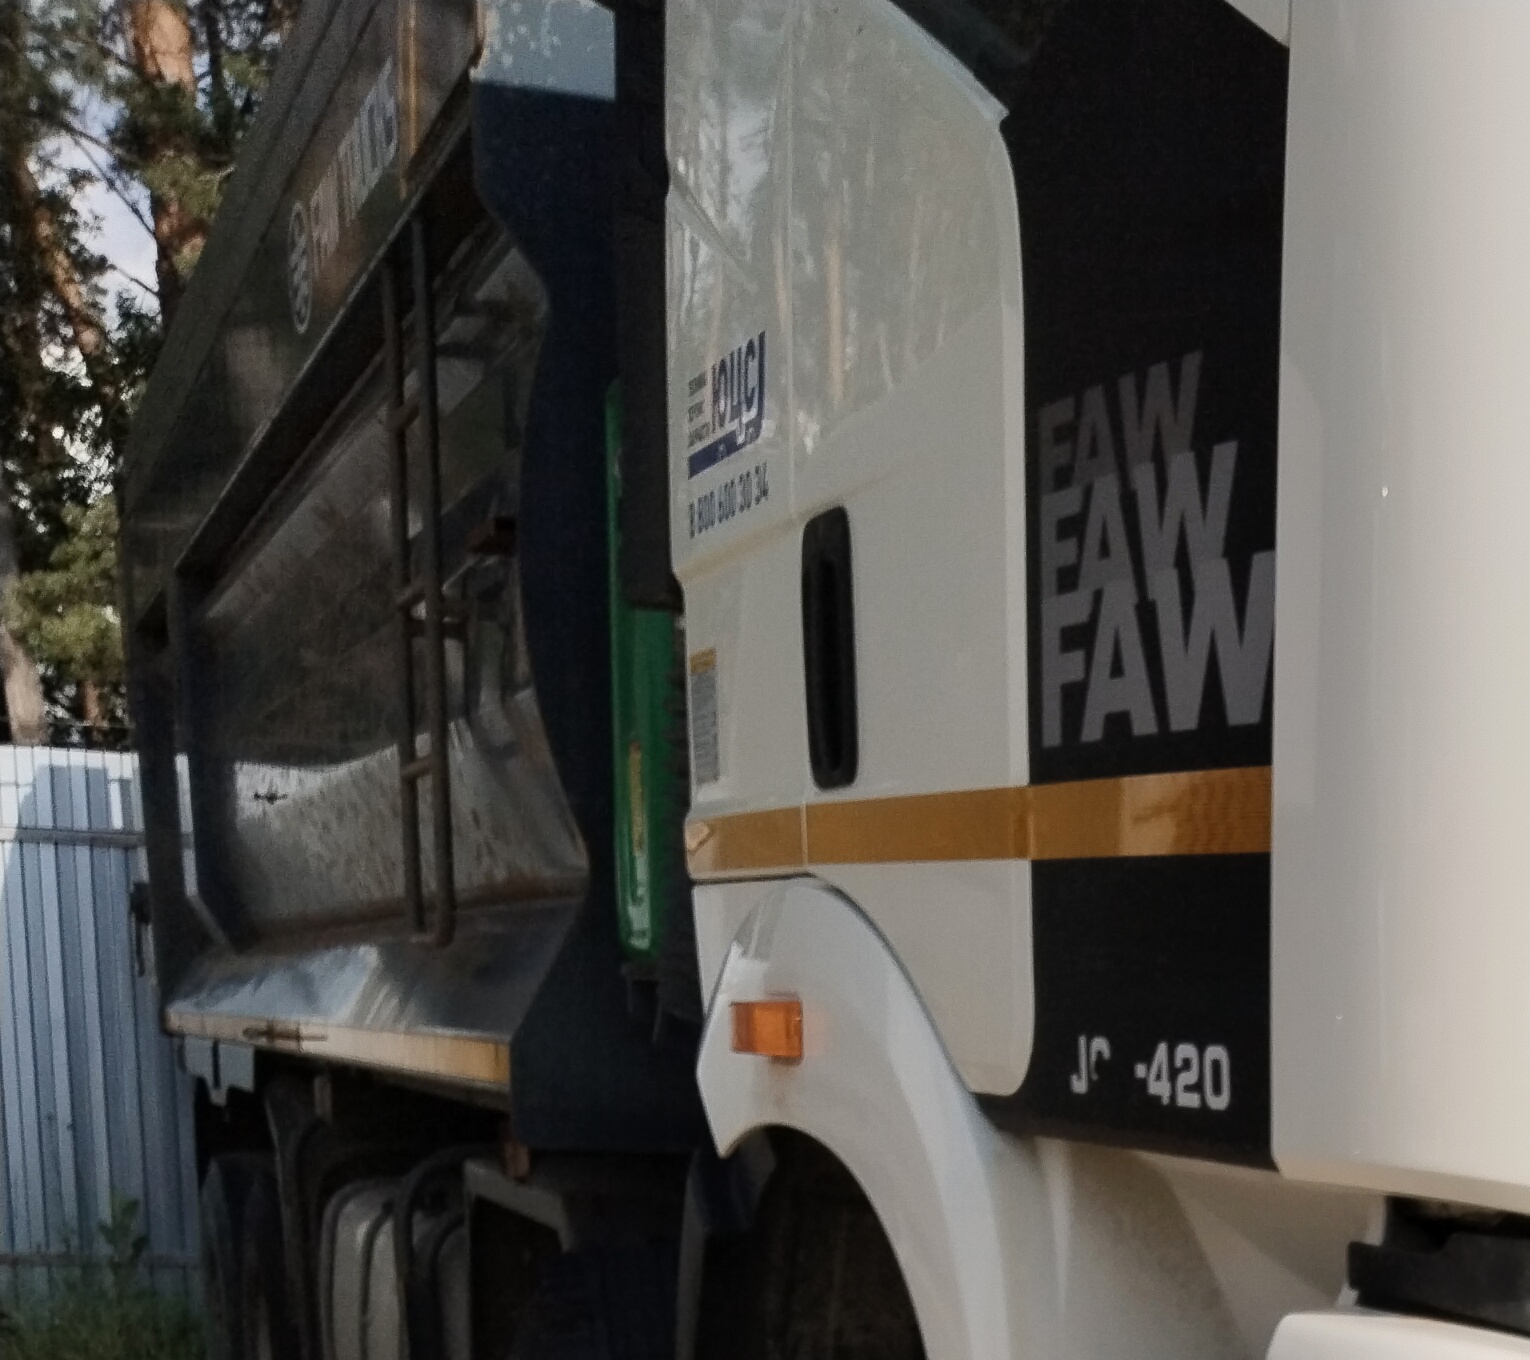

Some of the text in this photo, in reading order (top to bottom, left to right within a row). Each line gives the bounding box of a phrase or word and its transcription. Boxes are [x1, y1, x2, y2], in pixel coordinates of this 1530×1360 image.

[1038, 350, 1203, 496] FAW
[1040, 440, 1238, 602] FAW
[1042, 550, 1276, 749] FAW
